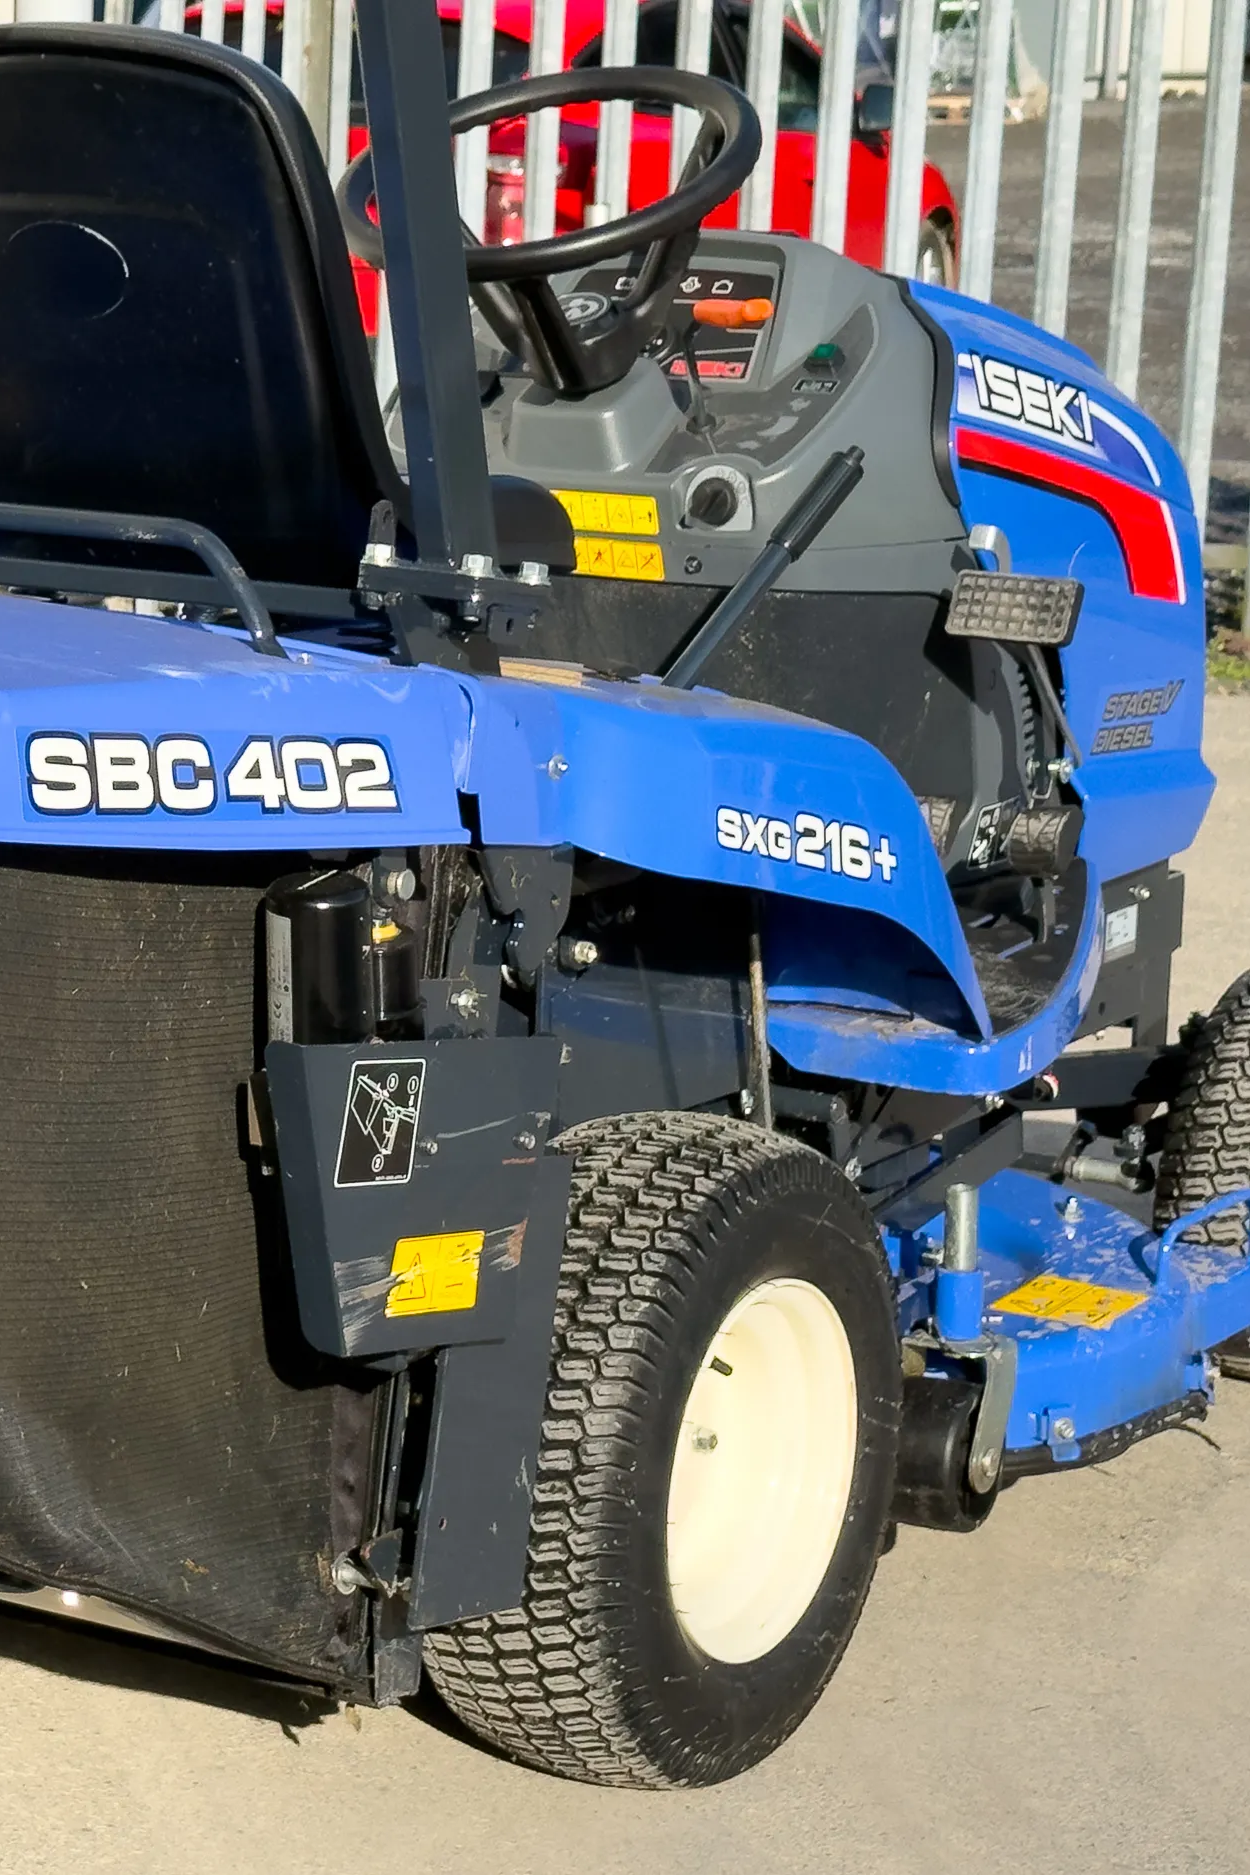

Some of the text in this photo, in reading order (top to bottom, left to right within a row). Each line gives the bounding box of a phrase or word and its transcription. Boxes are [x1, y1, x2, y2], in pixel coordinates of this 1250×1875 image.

[968, 350, 1095, 446] ISEKI
[26, 731, 402, 815] SBC 402
[1090, 721, 1153, 756] DIESEL
